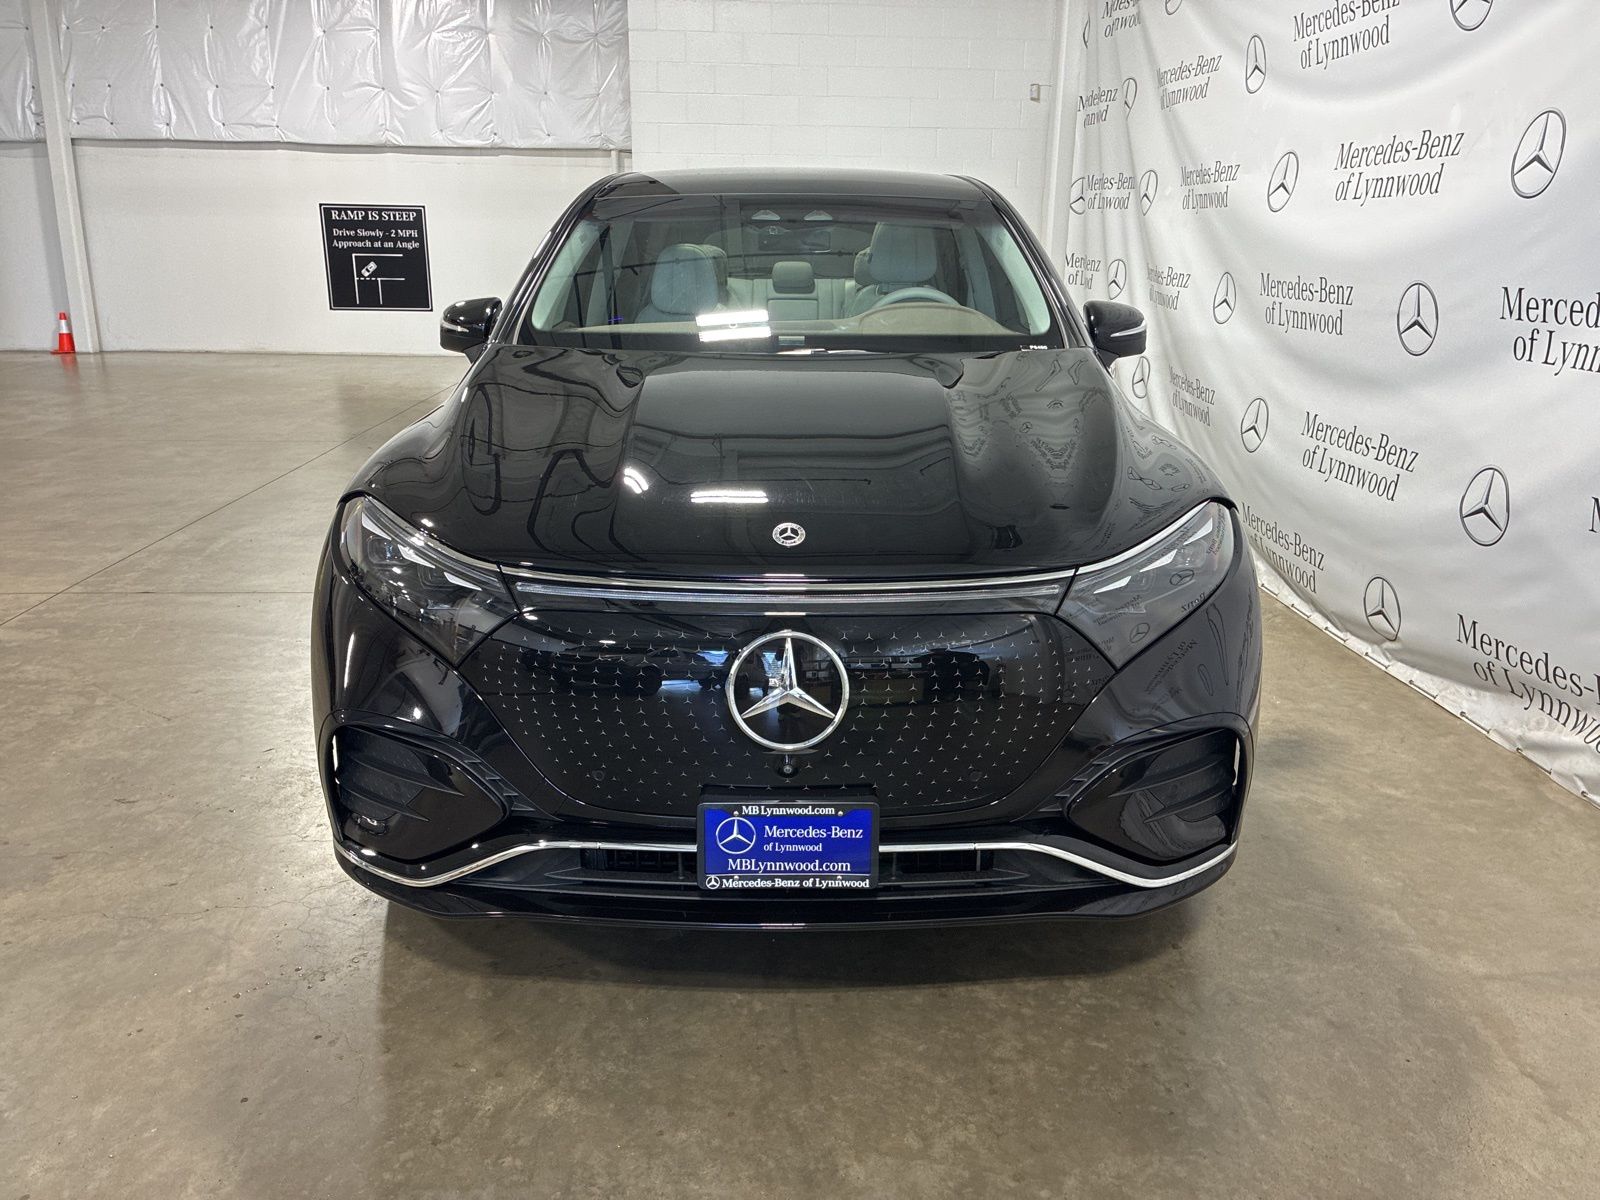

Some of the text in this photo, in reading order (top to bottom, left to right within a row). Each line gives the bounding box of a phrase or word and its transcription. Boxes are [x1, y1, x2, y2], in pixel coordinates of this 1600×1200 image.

[1301, 14, 1390, 70] of Lynnwood
[1334, 129, 1465, 171] Mercedes-Benz
[1180, 160, 1241, 187] Mercedes-Benz
[1335, 163, 1445, 207] of Lynnwood
[1087, 192, 1098, 210] of
[1182, 184, 1229, 215] of Lynnwood
[331, 210, 417, 221] RAMP IS STEEP
[332, 240, 372, 249] Approach
[373, 240, 381, 248] at
[395, 241, 420, 250] Angle
[333, 228, 355, 237] Drive
[357, 229, 384, 239] Slowly
[390, 229, 396, 238] 2
[398, 229, 418, 238] MPH
[1259, 272, 1354, 306] Mercedes-Benz
[1265, 301, 1344, 336] of Lynnwood
[1513, 328, 1530, 362] of
[1301, 411, 1419, 473] Mercedes-Benz
[1302, 446, 1400, 501] of Lynnwood
[1241, 502, 1325, 572] Mercedes-Benz
[1473, 660, 1600, 754] of Lynnwo
[741, 805, 835, 817] MB Lynnwood.com
[763, 825, 863, 839] Mercedes-Benz
[763, 842, 823, 854] of Lynnwood
[728, 858, 851, 874] MBLynnwood.com
[722, 877, 870, 890] Mercedes-Benz of Lynnwood
